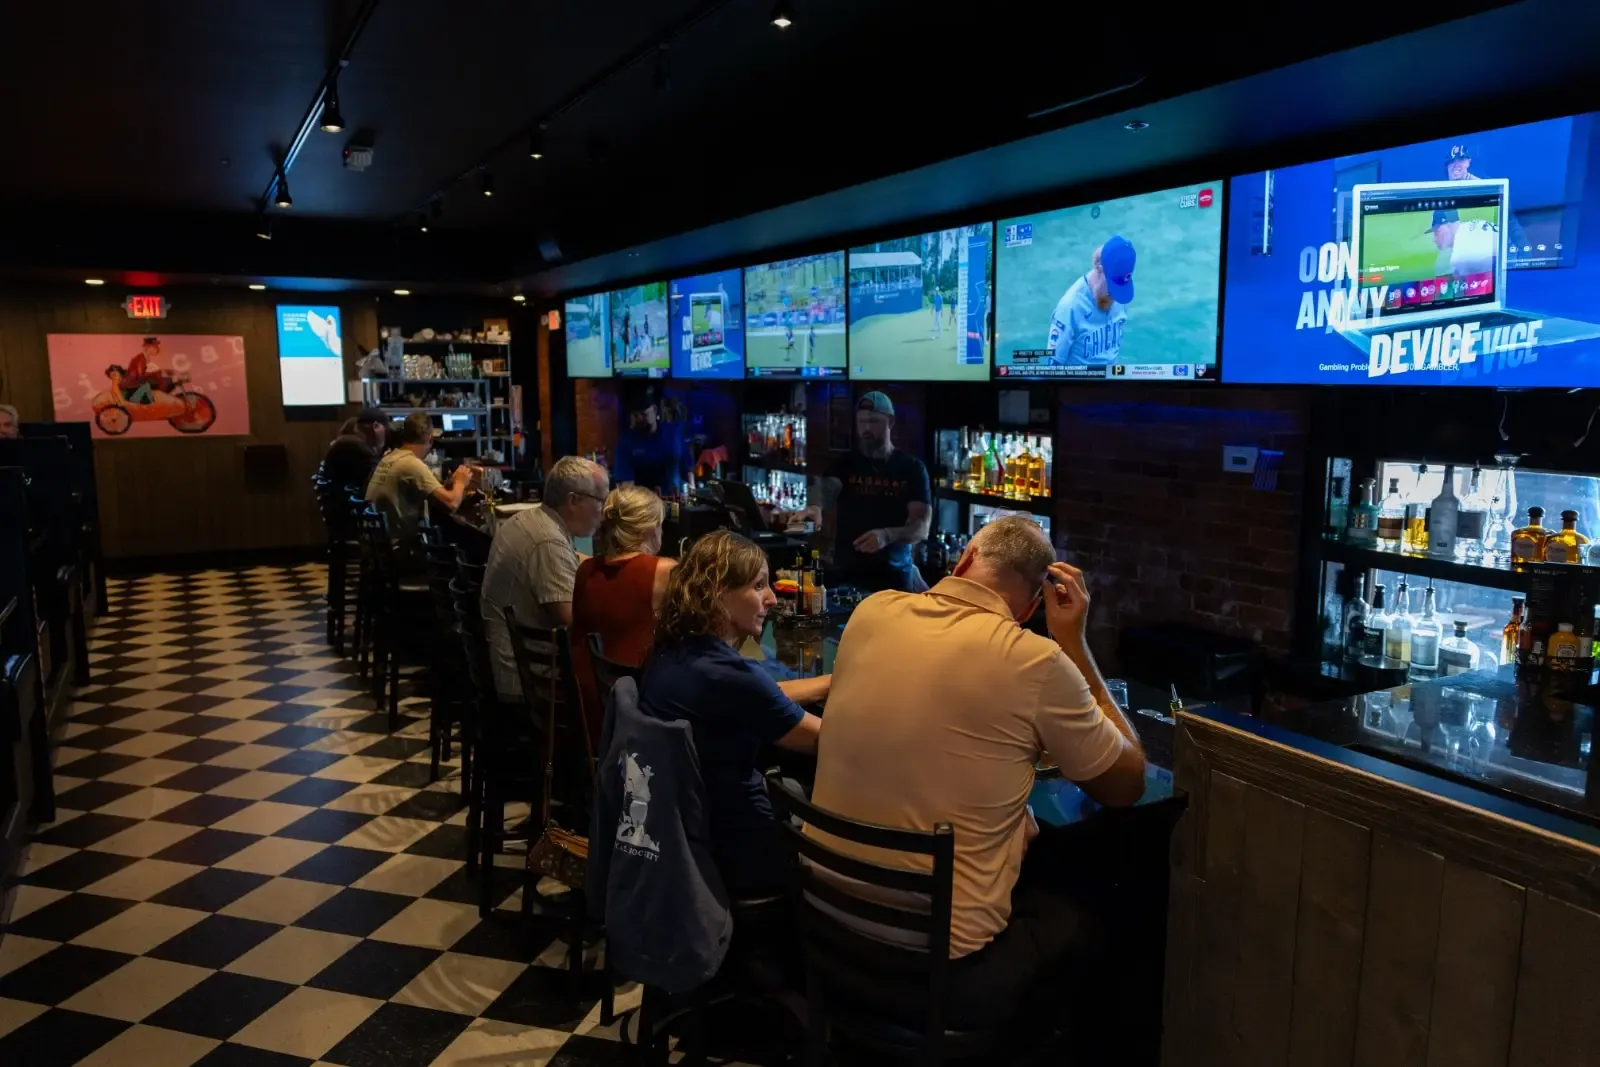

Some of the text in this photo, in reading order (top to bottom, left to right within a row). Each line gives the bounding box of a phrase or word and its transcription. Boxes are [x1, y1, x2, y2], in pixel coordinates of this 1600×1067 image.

[132, 296, 161, 316] EXIT
[1368, 321, 1481, 378] DEVICE
[1319, 363, 1349, 372] Gambling
